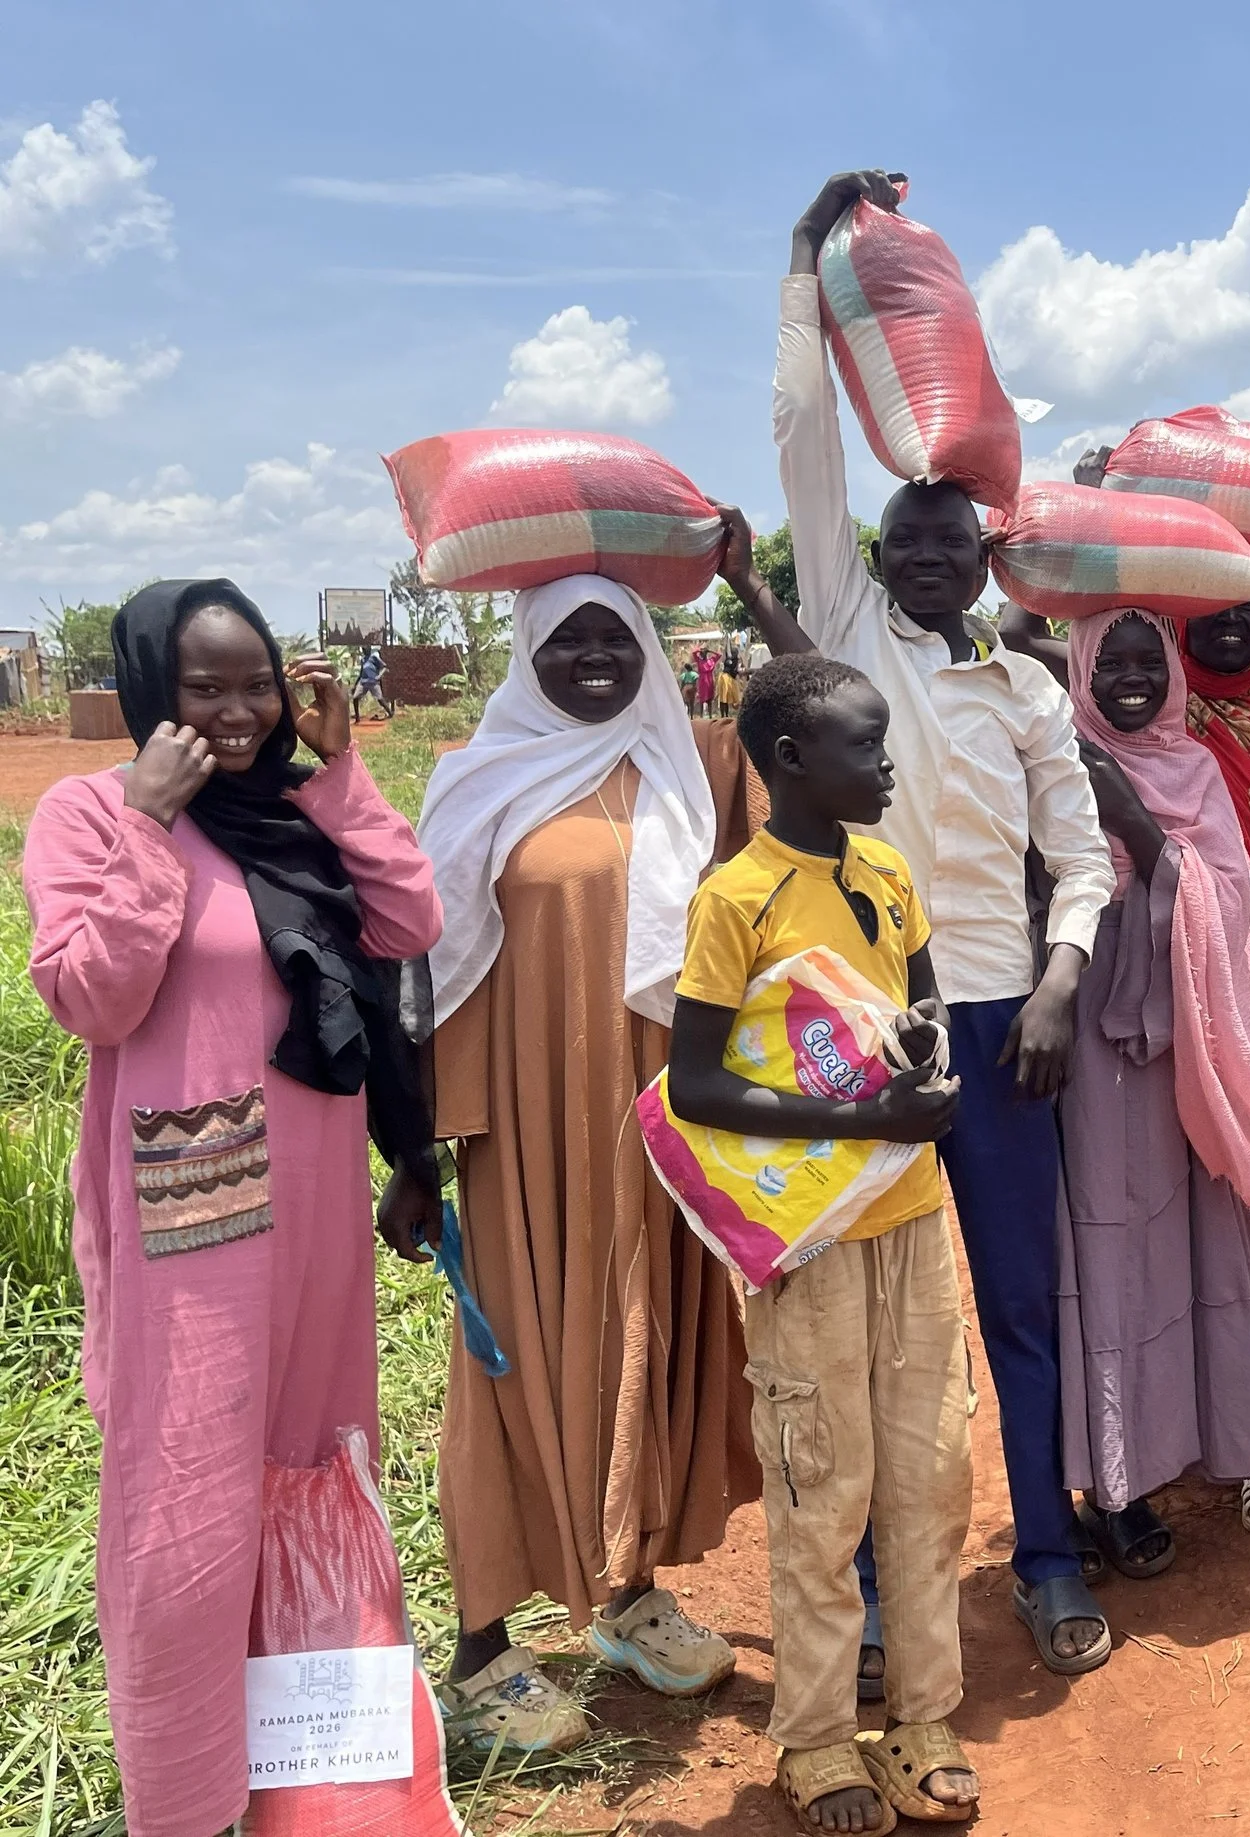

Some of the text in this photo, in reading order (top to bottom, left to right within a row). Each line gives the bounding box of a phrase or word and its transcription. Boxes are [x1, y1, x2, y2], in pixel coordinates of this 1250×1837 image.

[259, 1706, 391, 1727] RAMADAN MUBARAK
[309, 1723, 342, 1735] 2026
[328, 1749, 399, 1767] KHURAM
